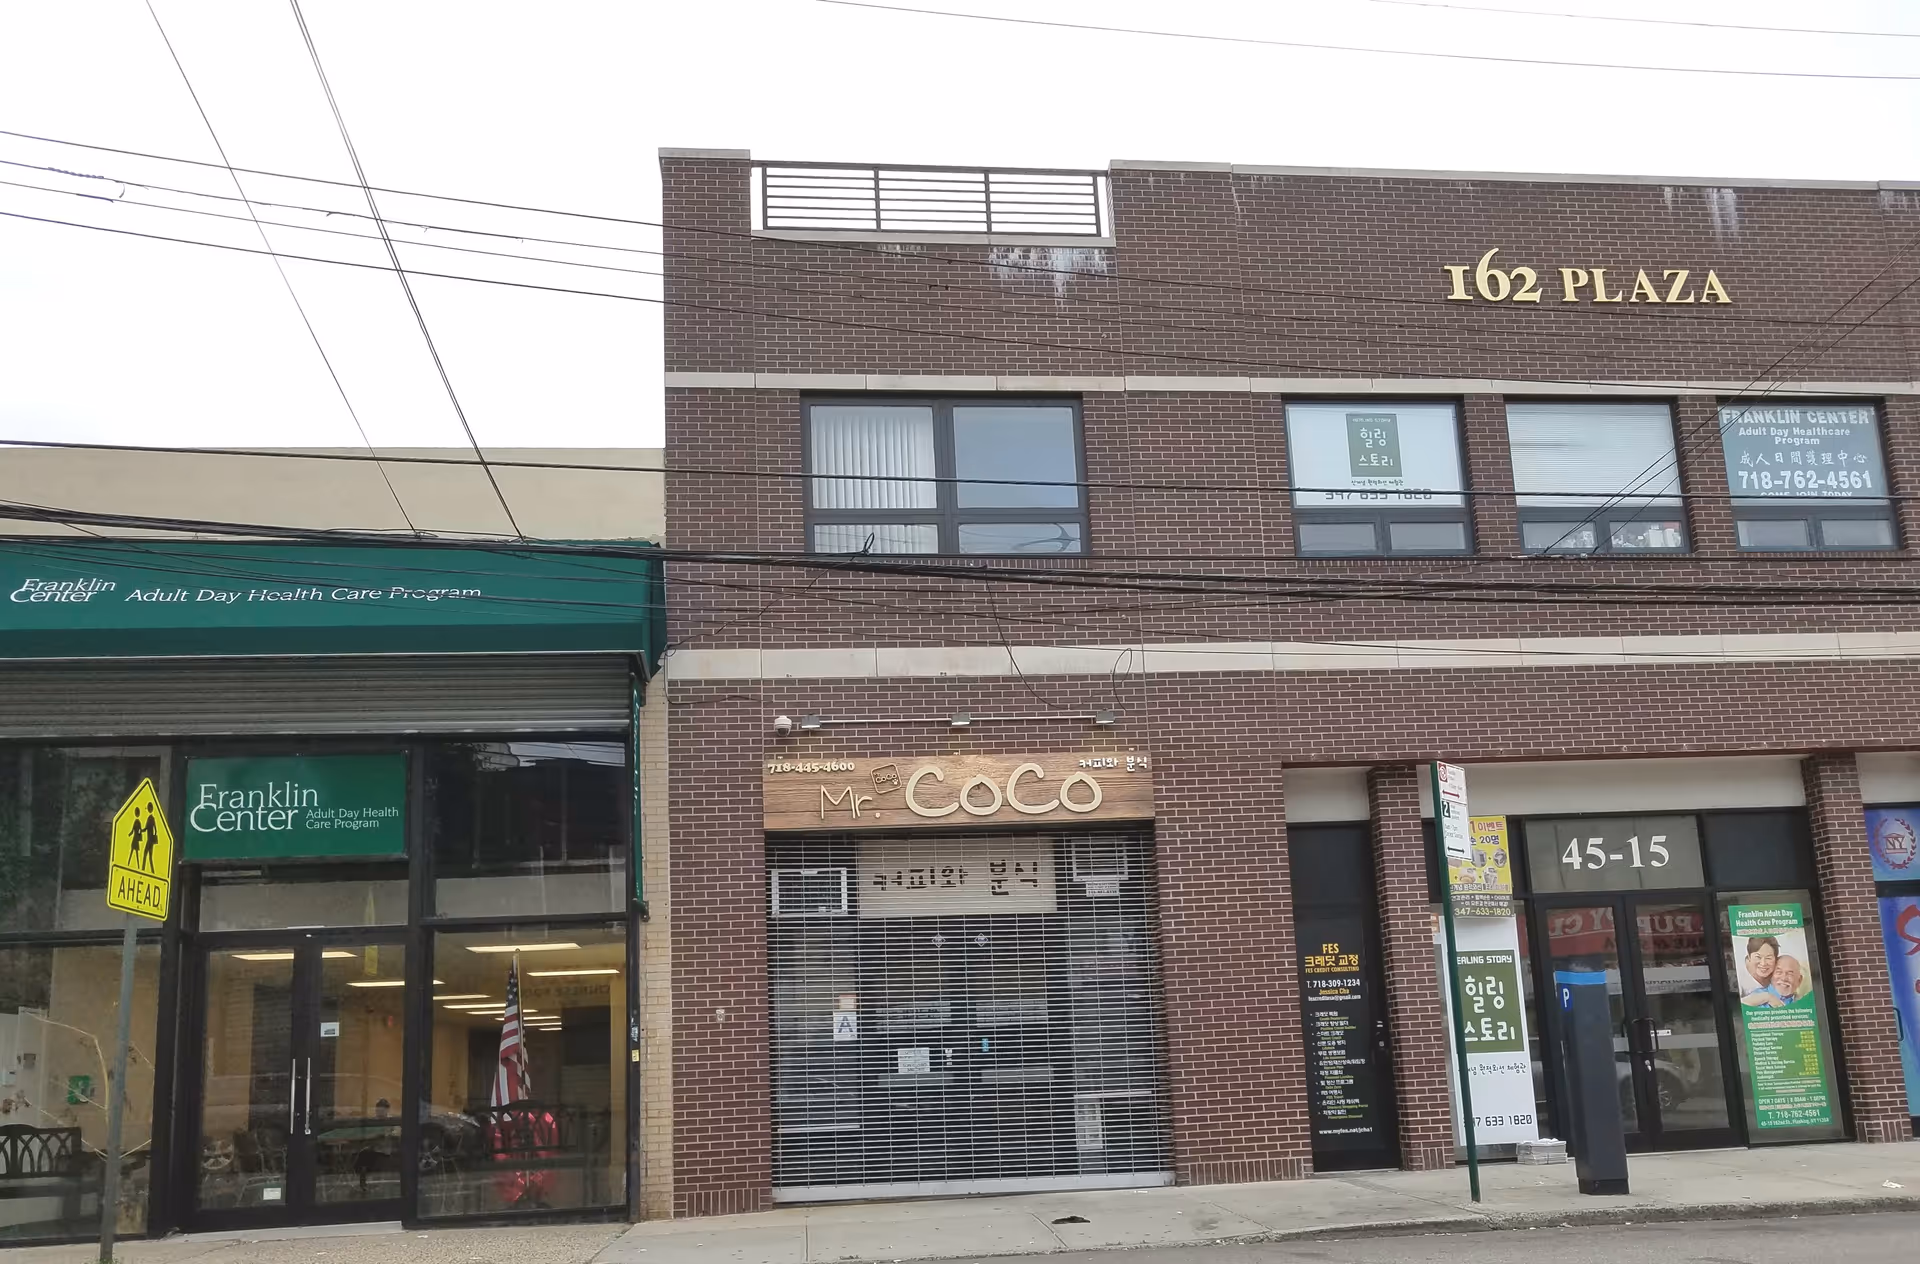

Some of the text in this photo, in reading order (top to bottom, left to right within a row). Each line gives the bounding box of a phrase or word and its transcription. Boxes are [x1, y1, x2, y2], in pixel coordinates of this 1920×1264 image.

[1444, 247, 1733, 304] 162 PLAZA
[1722, 409, 1869, 424] FRANKLIN CENTER
[1360, 427, 1386, 448] 힐링
[1739, 427, 1851, 437] Adult Day Healthcare
[1775, 437, 1820, 446] Program
[1358, 453, 1393, 466] 스토리
[1738, 470, 1872, 490] 718-762-4561
[21, 578, 116, 591] Franklin
[10, 587, 97, 602] Center
[124, 587, 482, 604] Adult Day Health Care Program
[768, 762, 856, 774] 718-445-4600
[1079, 757, 1148, 772] 커피와 분식
[199, 781, 318, 809] Franklin
[820, 785, 881, 819] Mr.
[190, 803, 298, 832] Center
[306, 807, 399, 820] Adult Day Health
[306, 819, 379, 830] Care Program
[1478, 821, 1504, 832] 이벤트
[1480, 834, 1500, 845] 20명
[1562, 835, 1669, 870] 45-15
[873, 859, 1038, 896] 커피와 분식
[118, 876, 161, 908] AHEAD
[1454, 907, 1511, 916] 347-633-1820
[1736, 919, 1757, 927] Health
[1322, 943, 1339, 954] FES
[1304, 954, 1359, 966] 크레딧 교정
[1457, 955, 1512, 965] EALING STORY
[1313, 979, 1360, 988] 718-309-1234
[1465, 975, 1505, 1013] 힐링
[838, 1016, 854, 1033] A
[1464, 1018, 1515, 1041] 스토리
[1479, 1064, 1504, 1075] 원적외선
[1507, 1062, 1526, 1074] 체험관
[1485, 1116, 1503, 1126] 633
[1508, 1114, 1532, 1125] 1820
[1776, 1109, 1820, 1118] 718-762-4561
